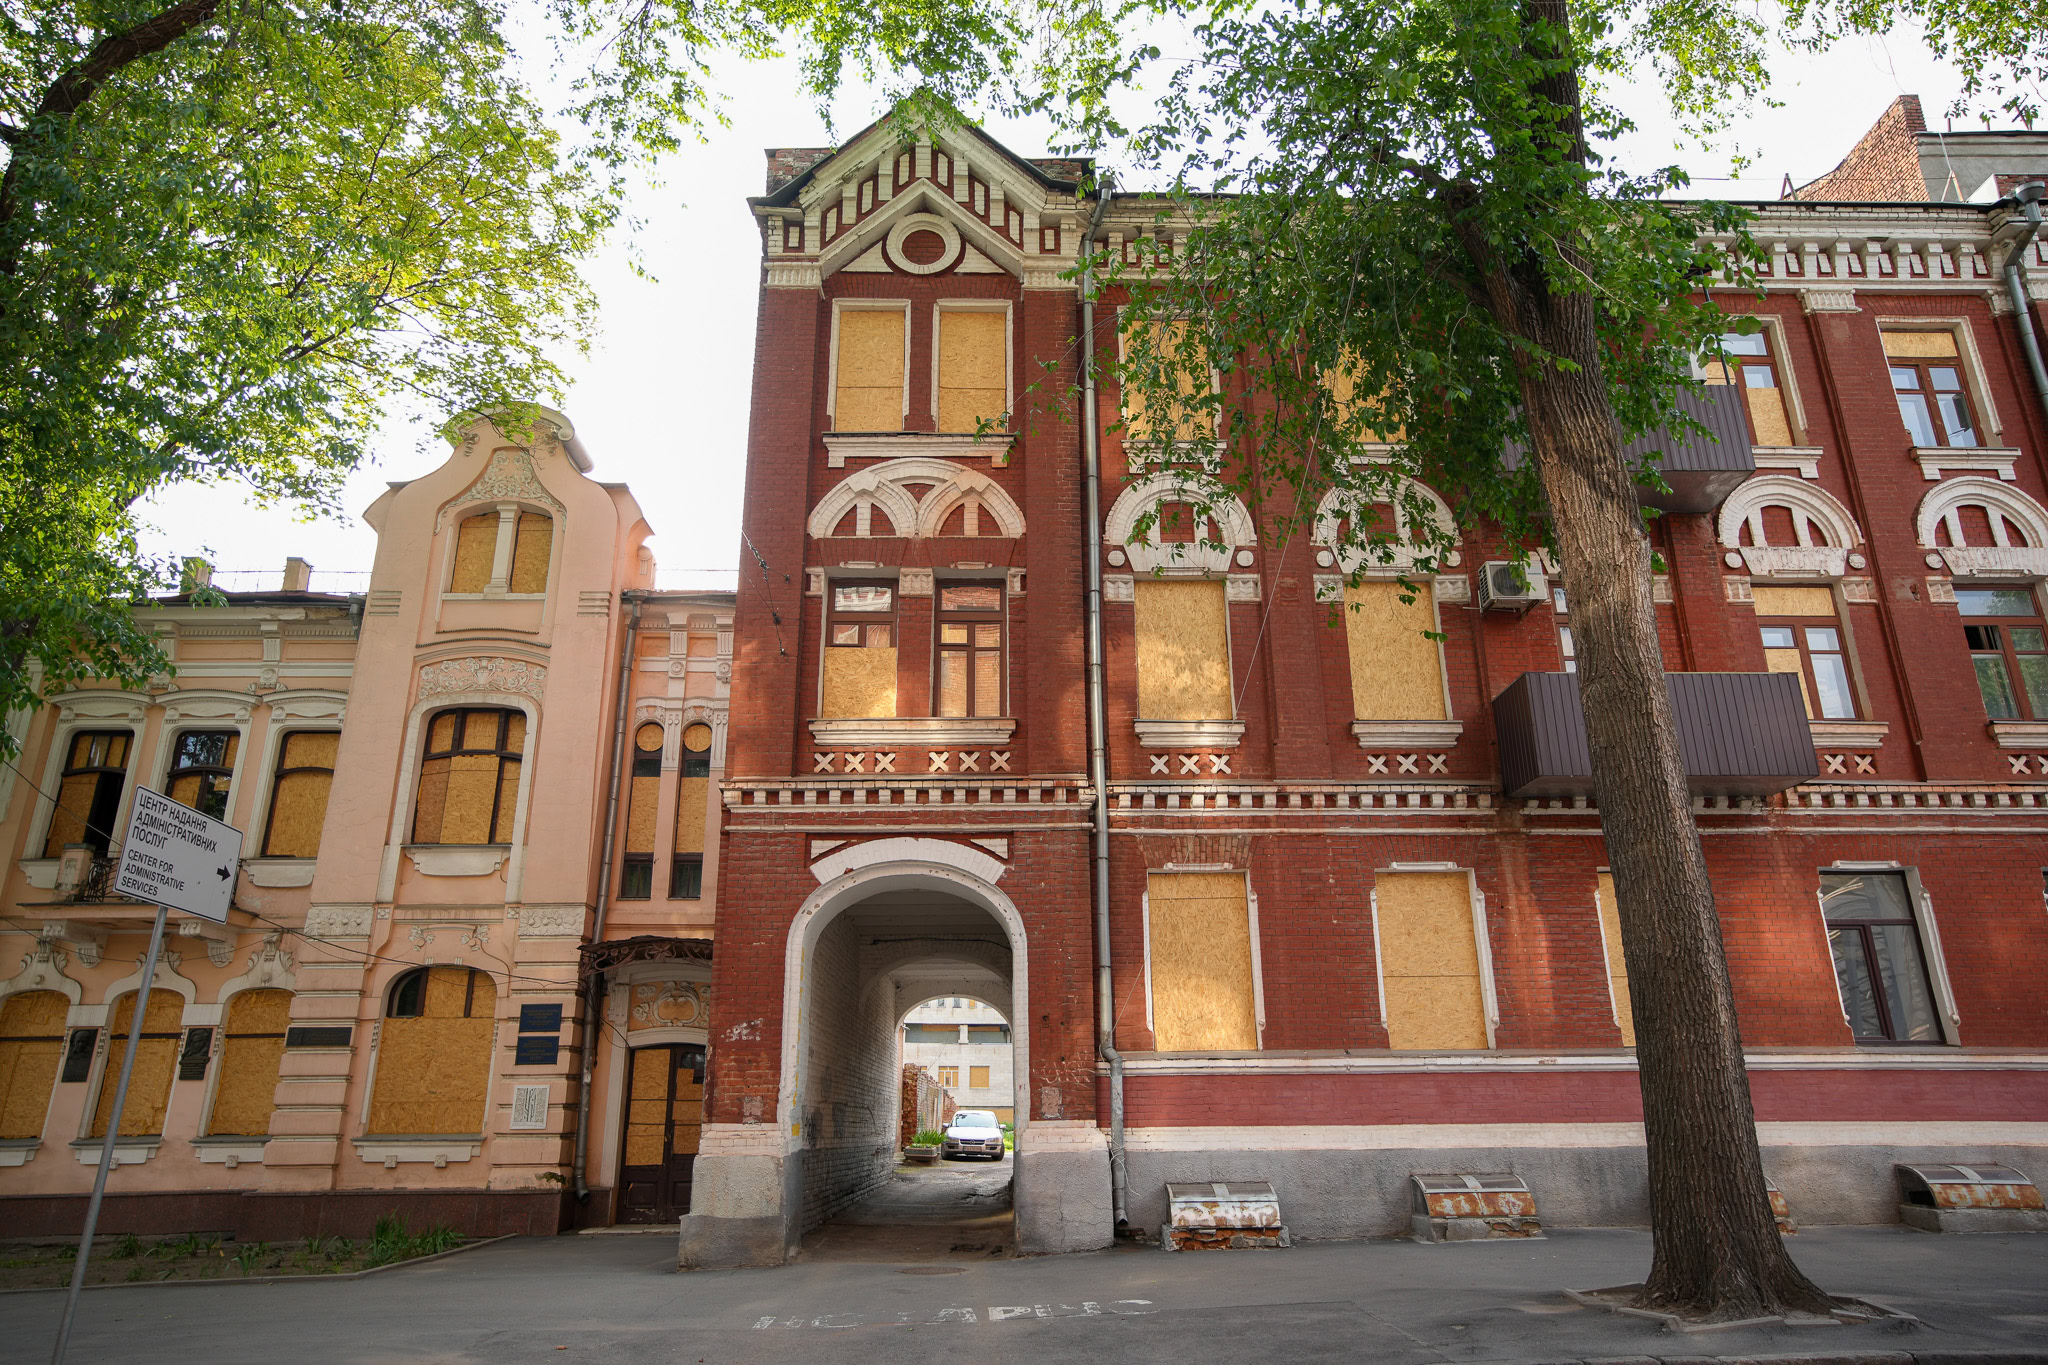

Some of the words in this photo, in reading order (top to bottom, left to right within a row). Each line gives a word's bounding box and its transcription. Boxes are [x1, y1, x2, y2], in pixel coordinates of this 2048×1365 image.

[139, 794, 168, 815] ЦЕНТР
[169, 807, 208, 832] НАДАННЯ
[132, 826, 168, 849] ПОСЛУГ
[136, 811, 218, 853] АДМІНІСТРАТИВНИХ
[128, 849, 157, 867] CENTER
[159, 861, 174, 873] FOR
[121, 876, 158, 896] SERVICES
[125, 863, 185, 891] ADMINISTRATIVE
